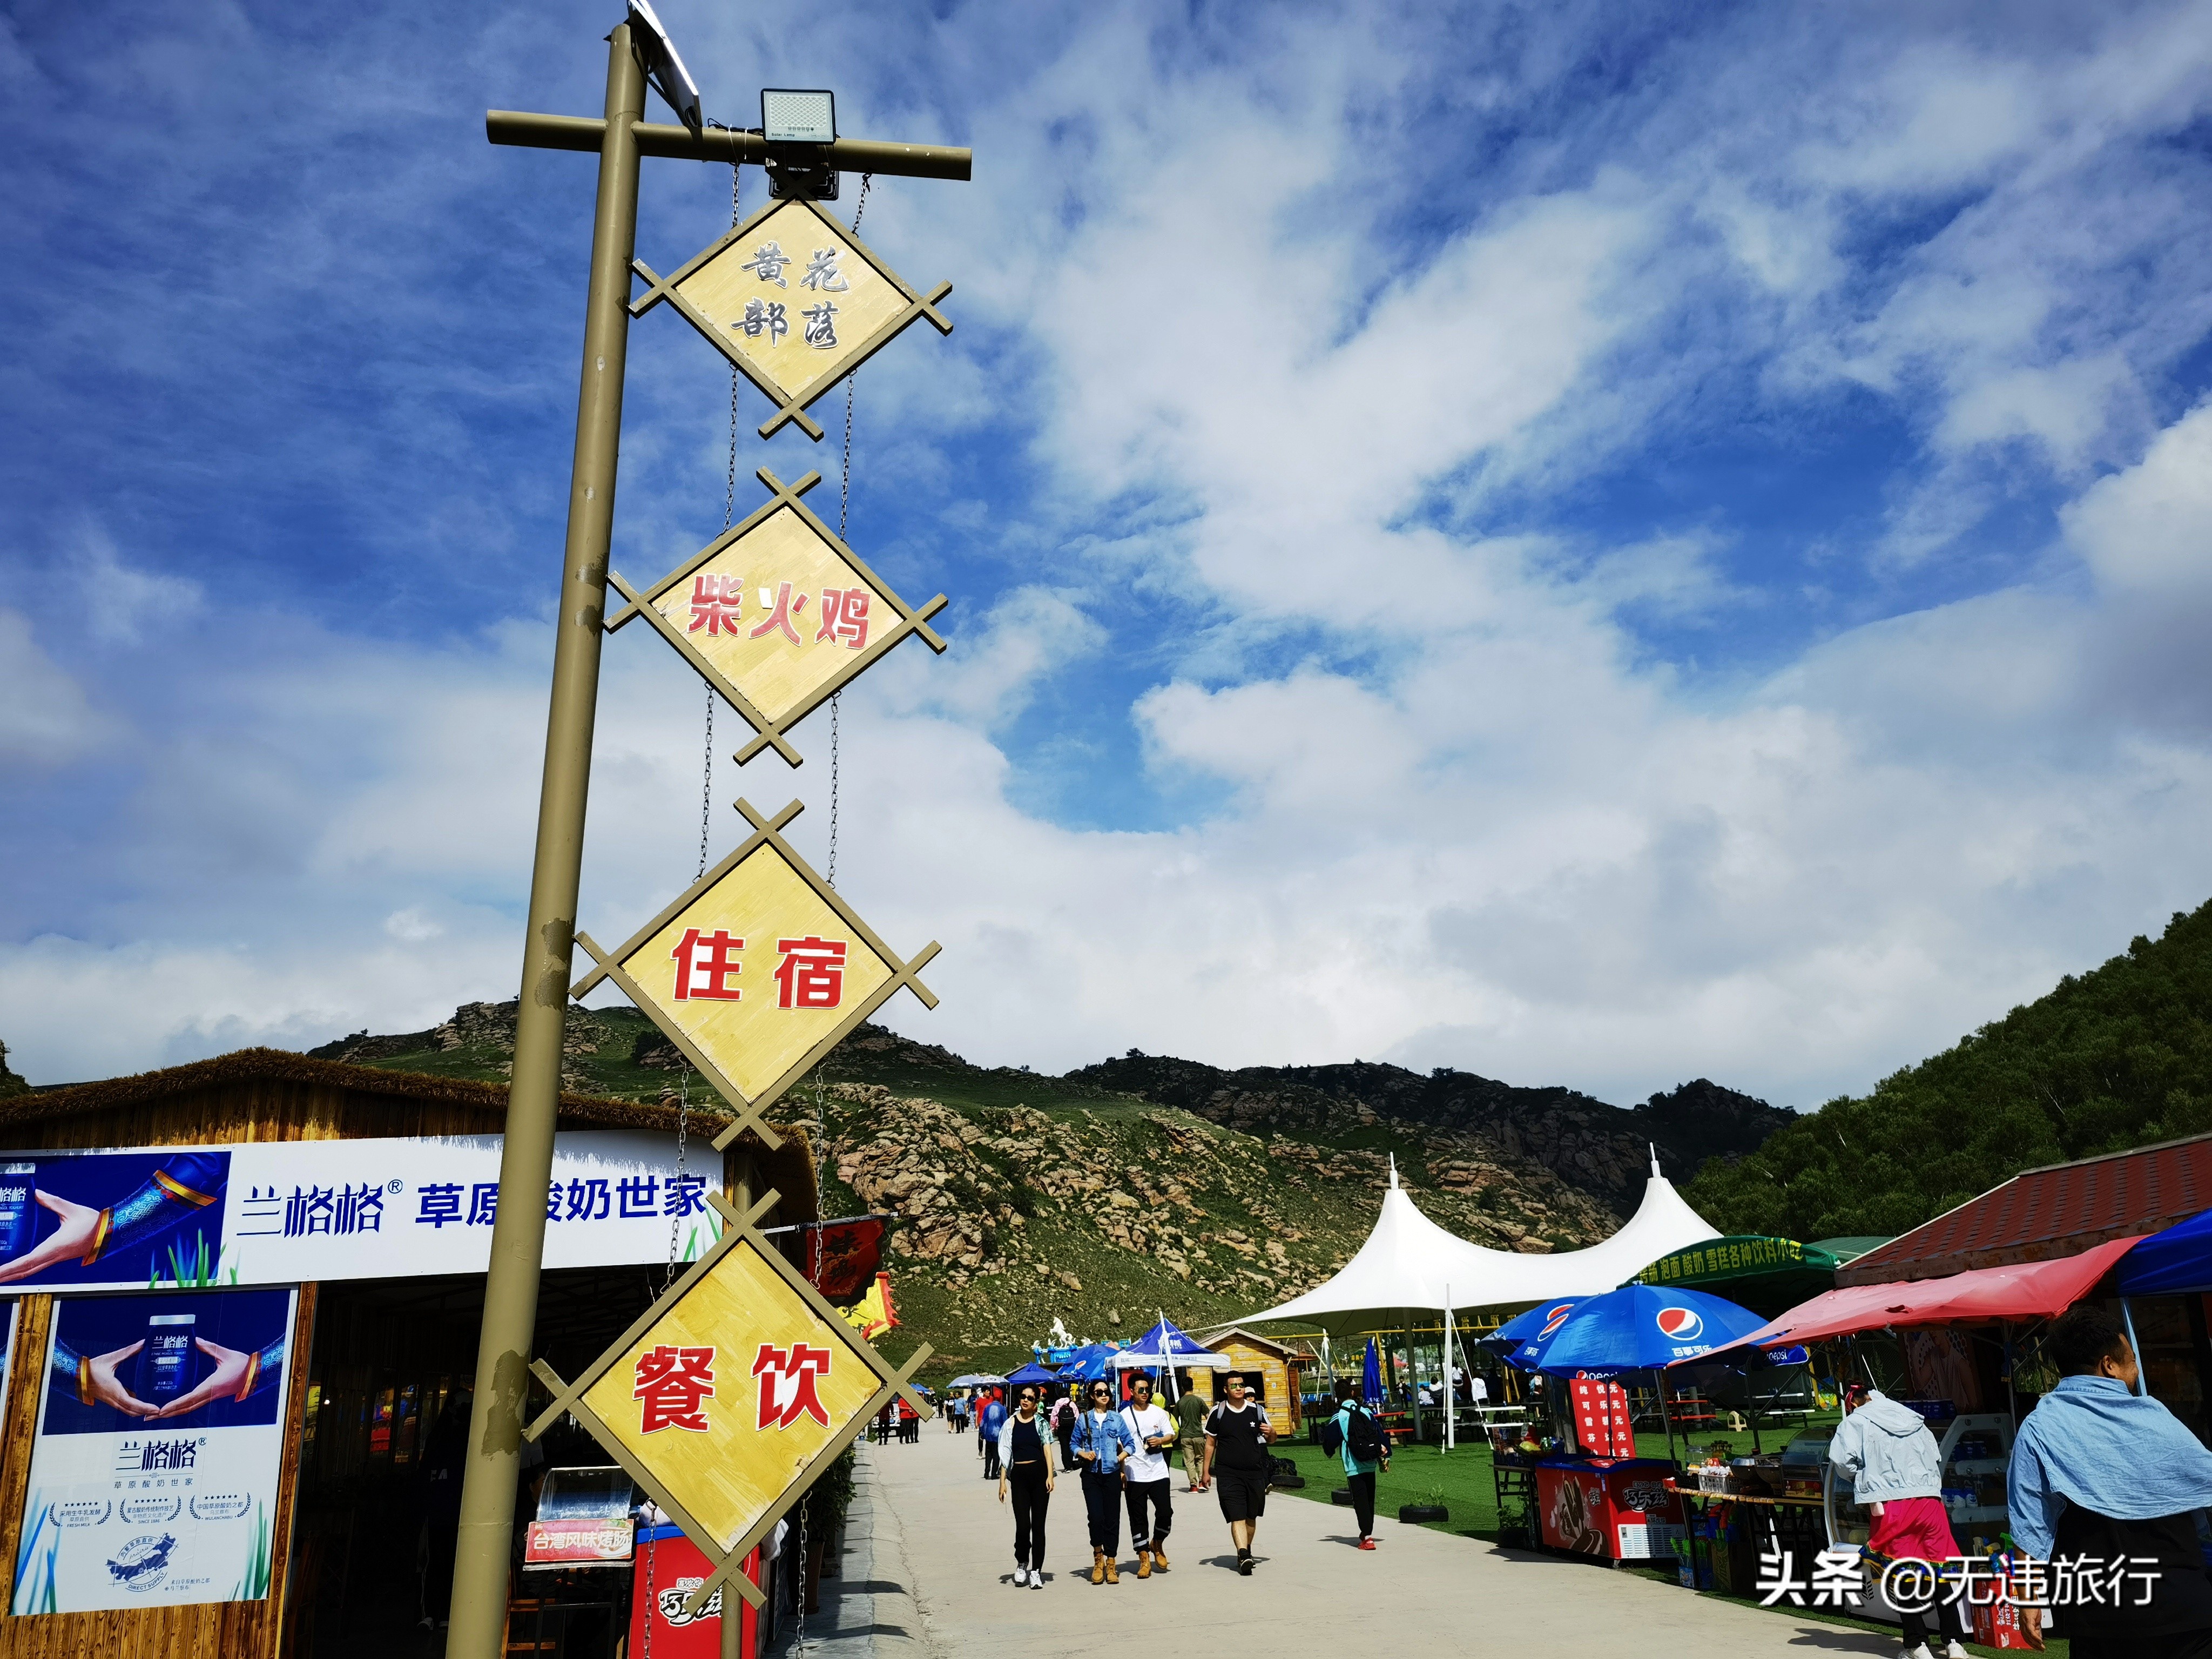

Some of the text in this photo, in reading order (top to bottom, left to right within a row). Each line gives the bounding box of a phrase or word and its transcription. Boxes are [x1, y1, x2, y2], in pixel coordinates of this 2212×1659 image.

[740, 240, 849, 291] 黄花
[731, 296, 840, 349] 部落
[687, 574, 871, 649] 柴火鸡
[670, 927, 848, 1009] 住宿
[1660, 1256, 1681, 1280] 泡面
[1682, 1251, 1704, 1275] 酸奶
[152, 1335, 188, 1349] 兰格格
[632, 1342, 832, 1434] 餐饮
[114, 1478, 193, 1489] 草原酸奶世家
[534, 1530, 630, 1550] 台湾风味烤肠
[149, 1572, 165, 1588] SUPPLY
